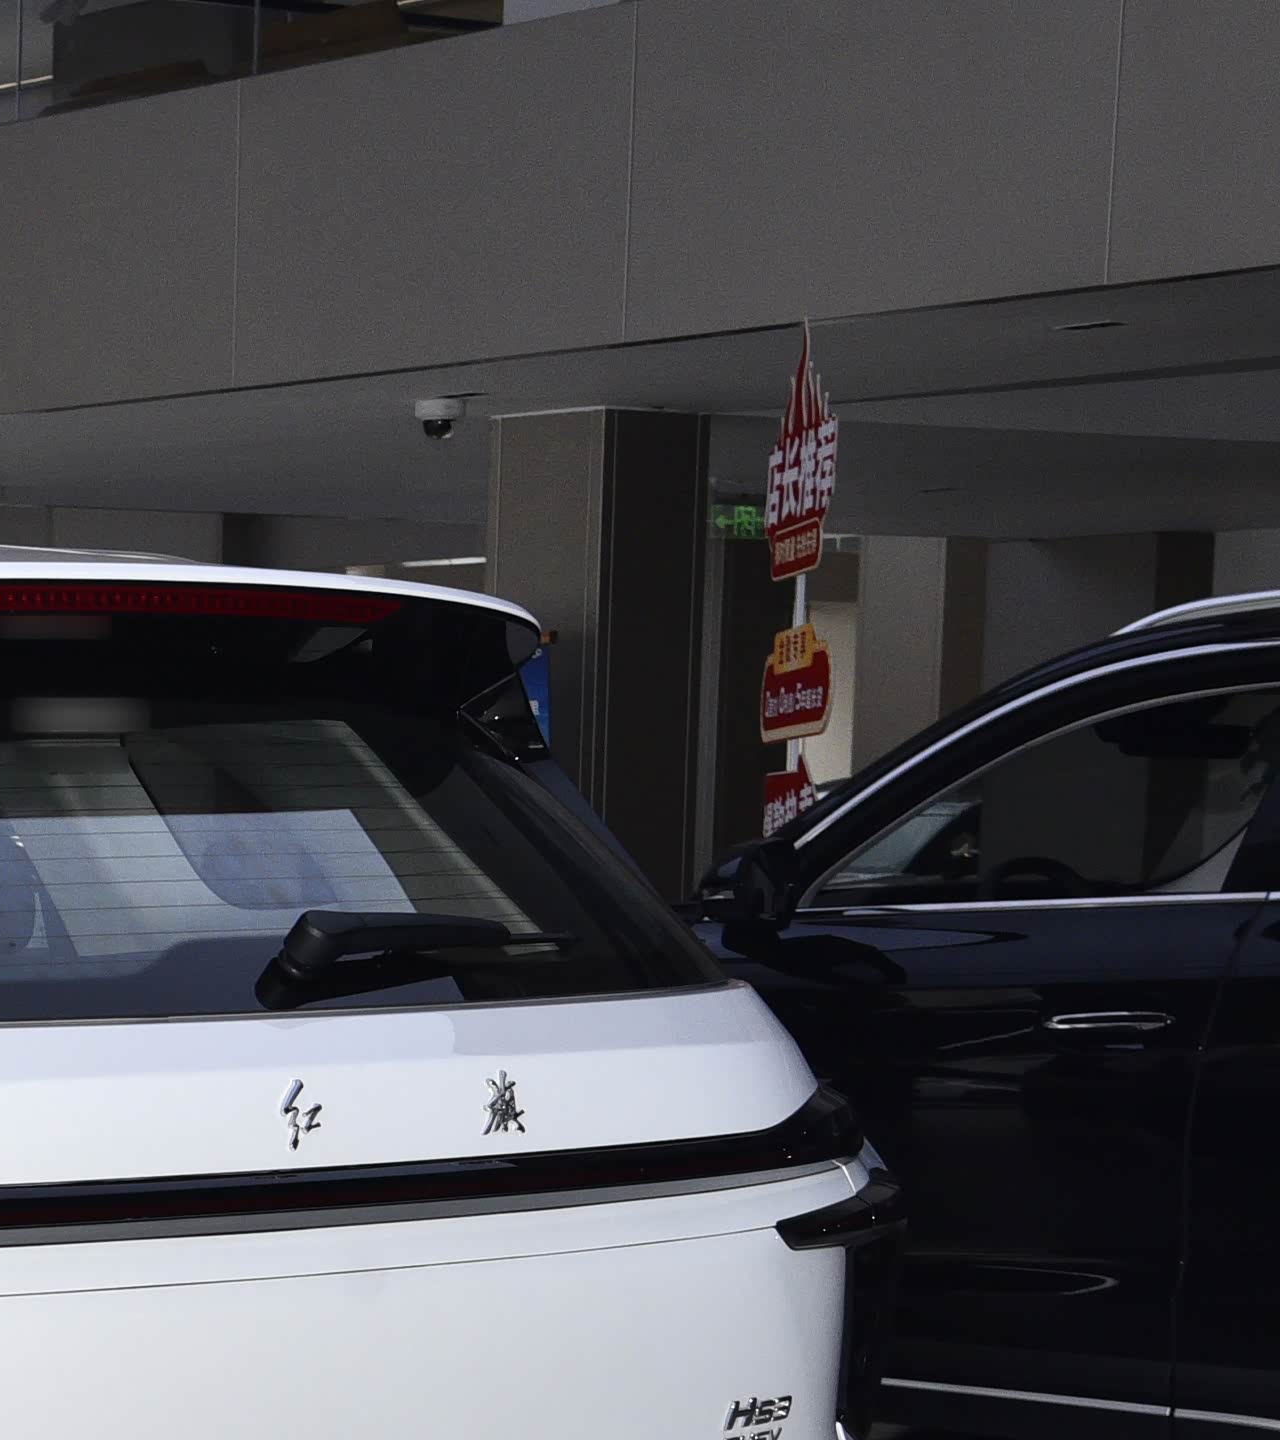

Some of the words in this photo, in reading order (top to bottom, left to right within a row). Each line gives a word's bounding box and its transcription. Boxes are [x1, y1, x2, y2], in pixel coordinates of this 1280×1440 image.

[764, 413, 839, 528] 店长推荐
[723, 1395, 793, 1431] HS3
